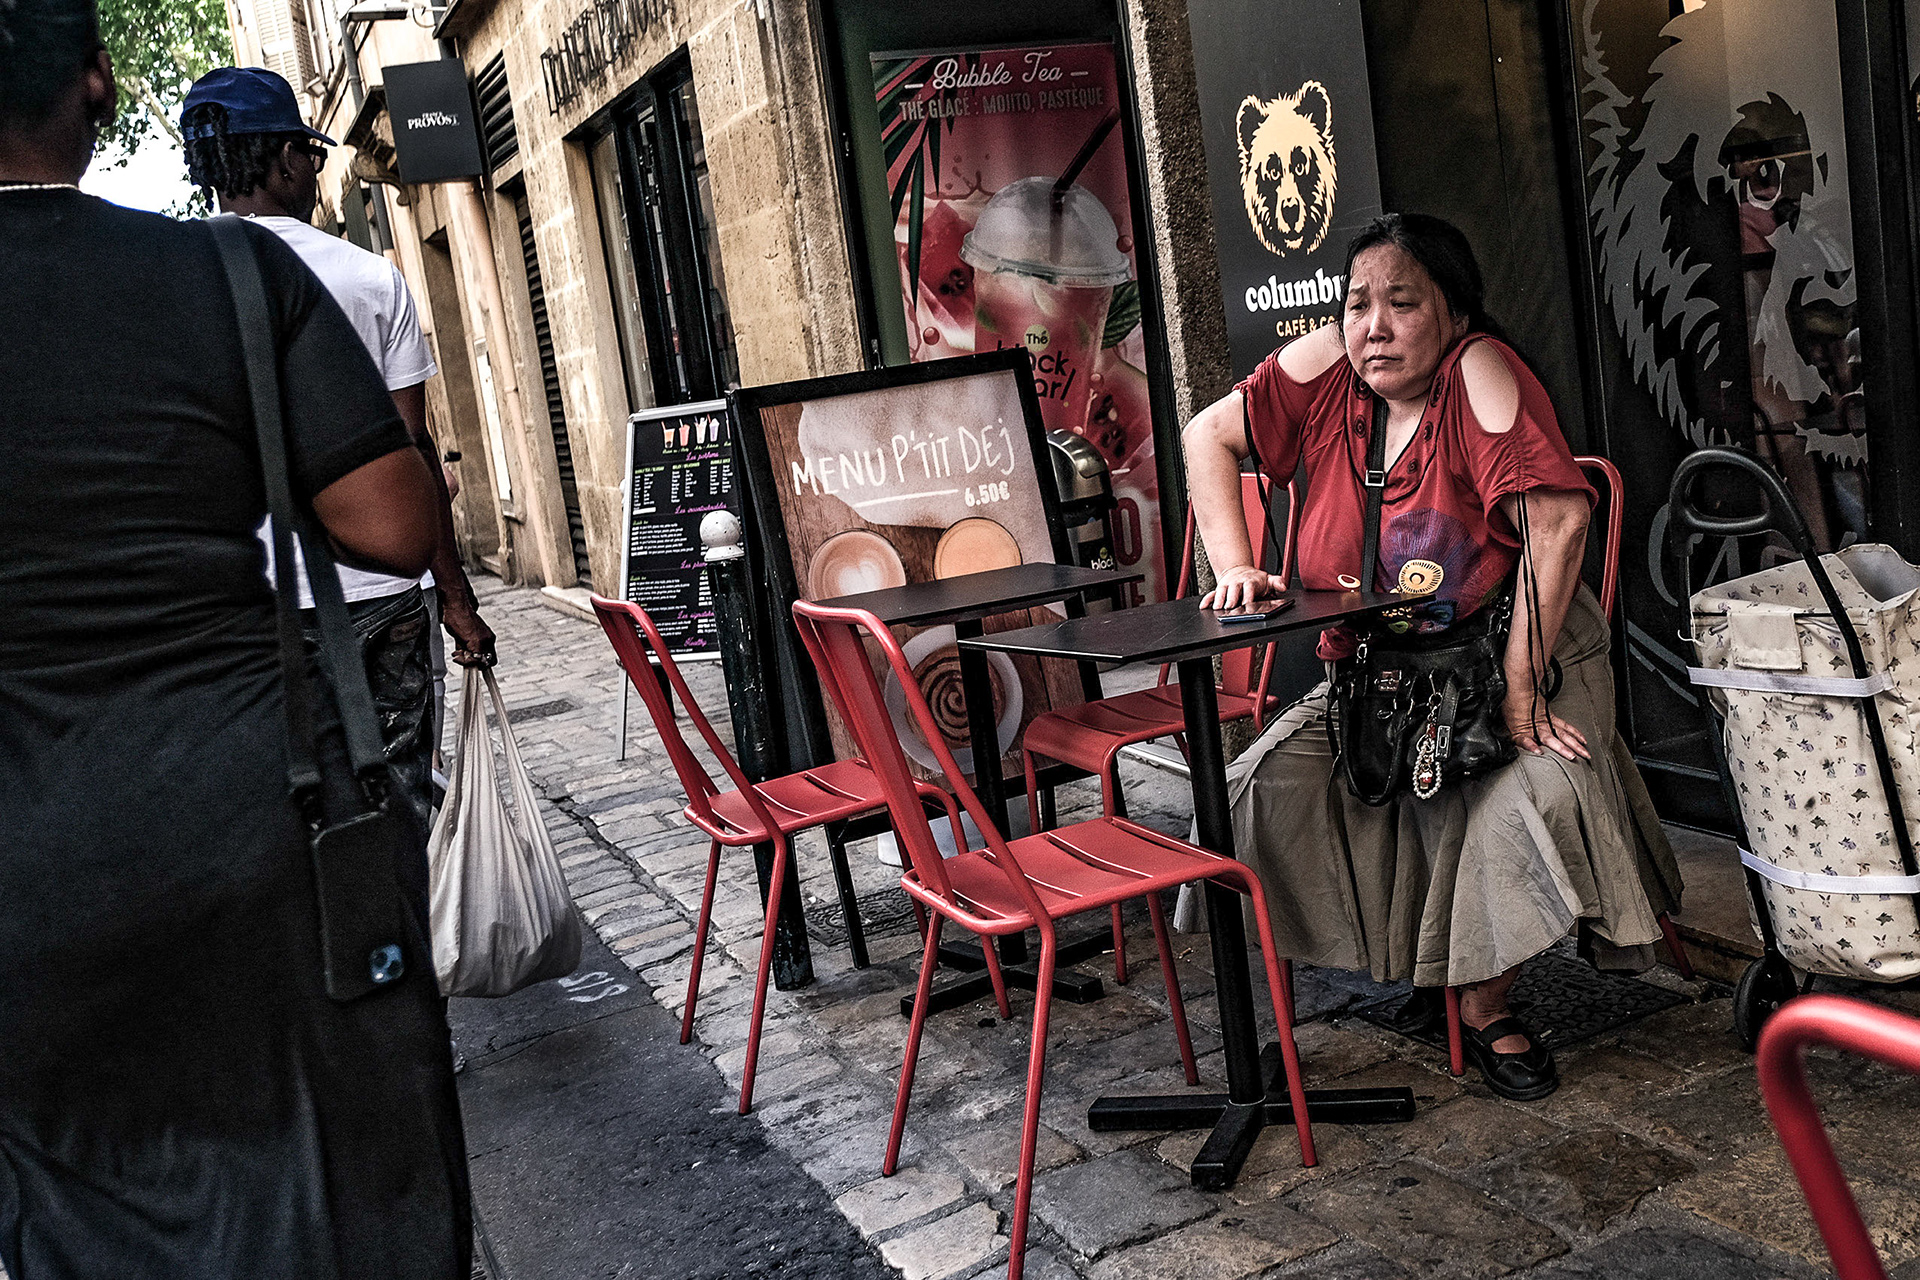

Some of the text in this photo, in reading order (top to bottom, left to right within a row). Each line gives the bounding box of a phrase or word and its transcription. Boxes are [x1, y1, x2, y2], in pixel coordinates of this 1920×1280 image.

[932, 51, 1064, 90] Bubble Tea
[900, 94, 928, 121] THÉ
[929, 90, 970, 119] GLACÉ
[1039, 81, 1104, 110] PASTÈQUE
[1026, 330, 1050, 345] Thé
[1276, 314, 1307, 337] CAFÉ
[791, 447, 886, 496] MENU
[964, 480, 1011, 507] 6.50€
